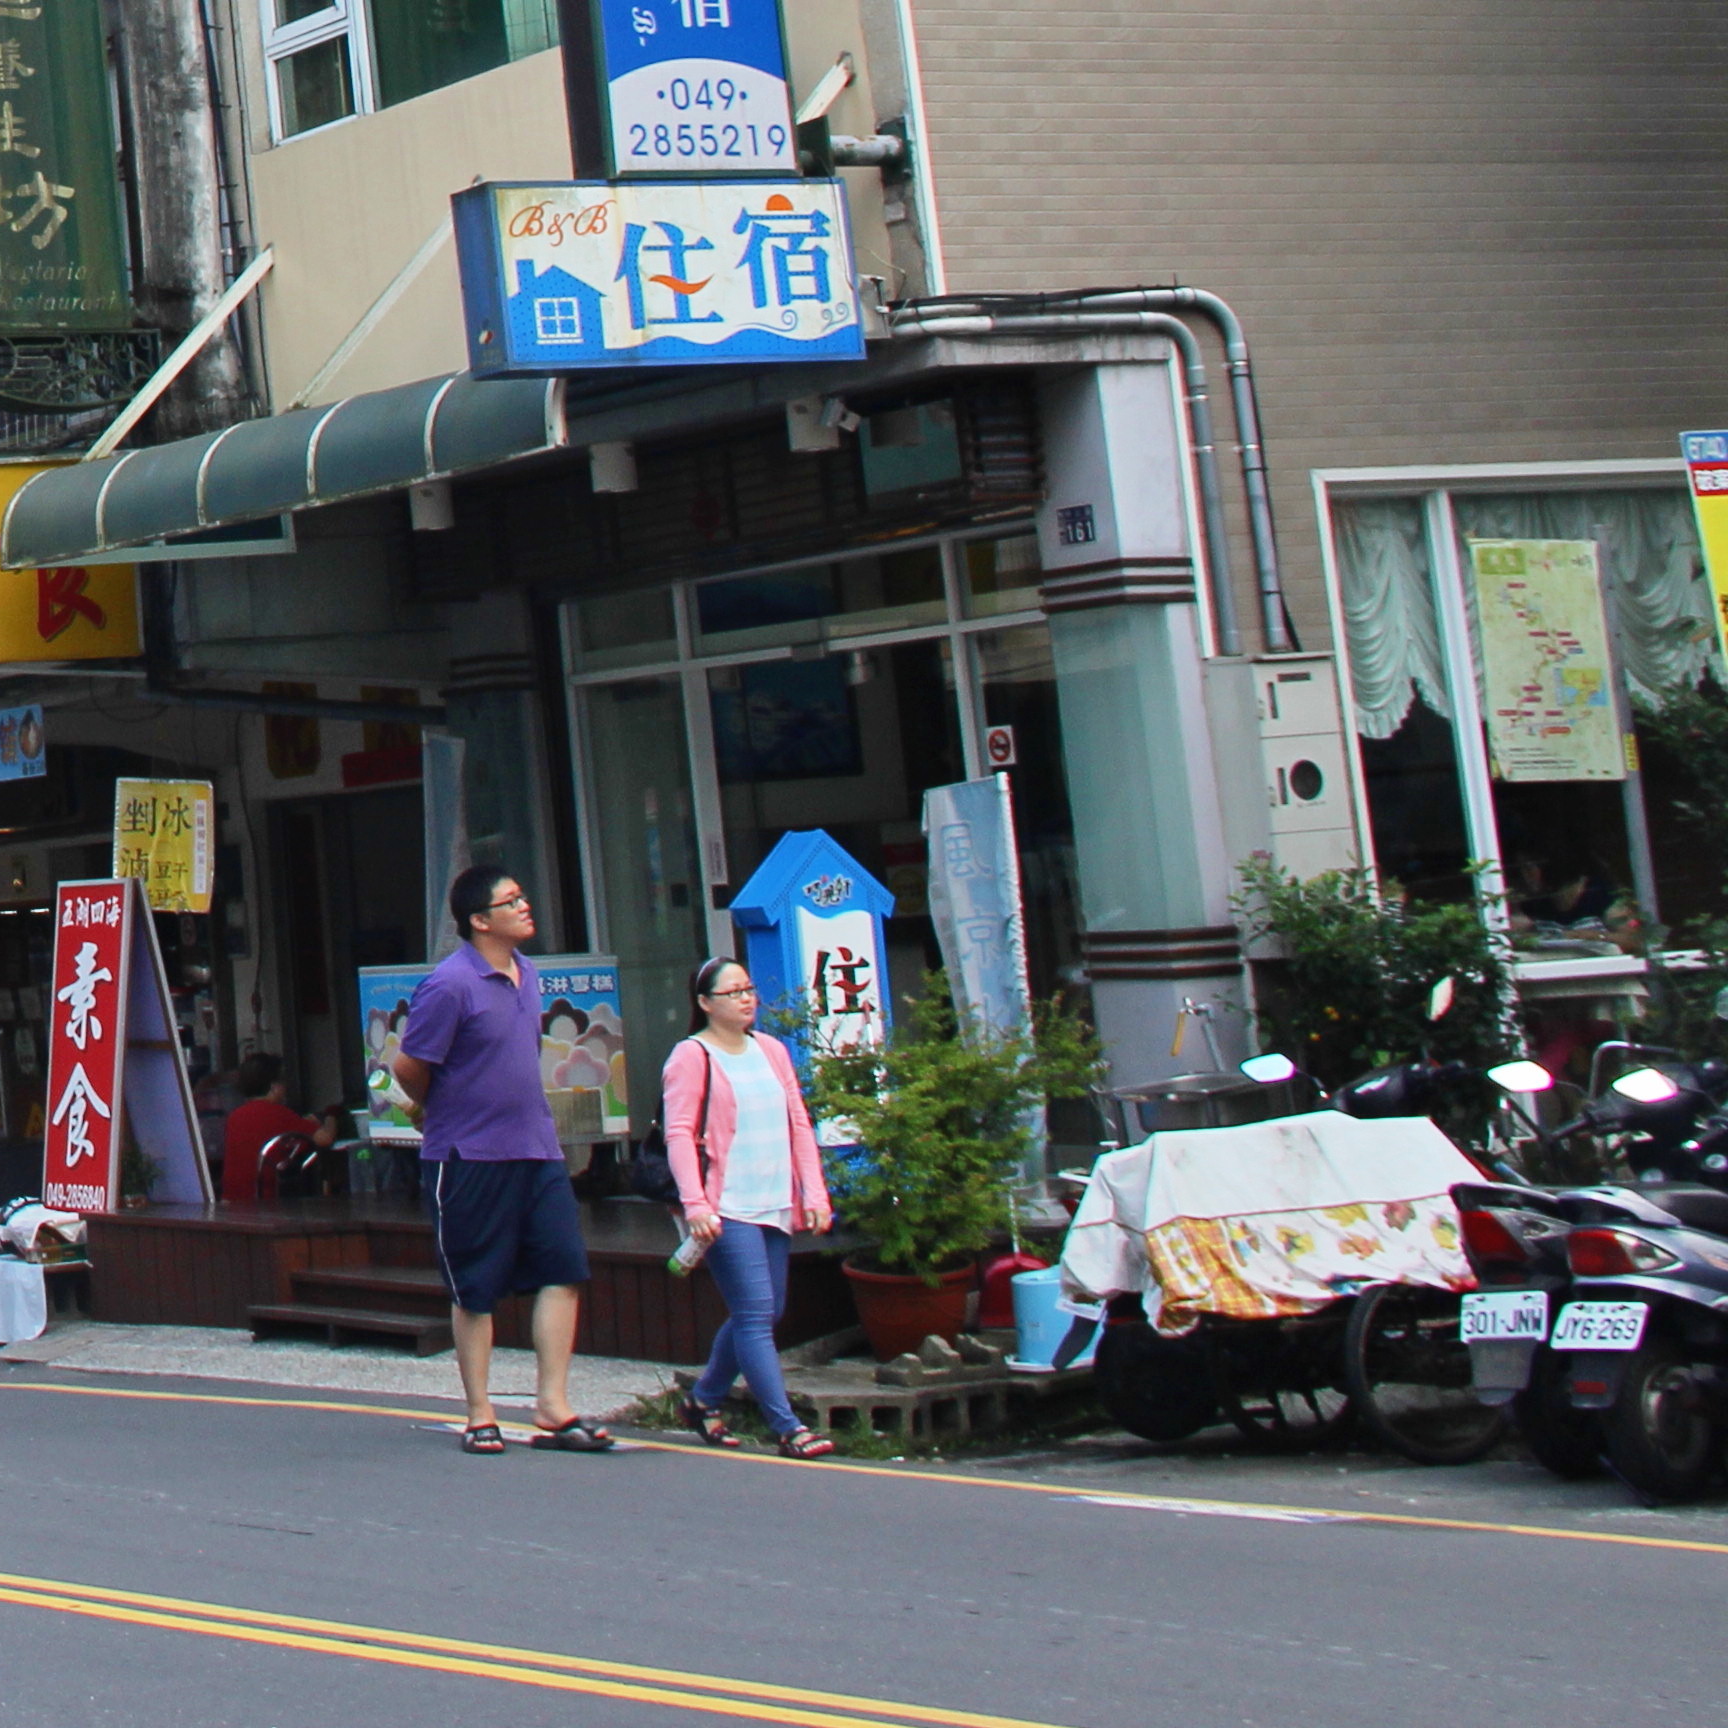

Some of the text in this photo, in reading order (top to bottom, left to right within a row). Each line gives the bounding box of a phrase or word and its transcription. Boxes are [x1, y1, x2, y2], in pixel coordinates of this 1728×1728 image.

[629, 123, 786, 157] 2855219
[509, 198, 619, 249] B&B
[615, 204, 834, 332] 住宿
[61, 897, 122, 929] 五湖四海
[812, 946, 877, 1019] 住
[52, 940, 113, 1169] 素食
[46, 1180, 106, 1211] 049-2856840
